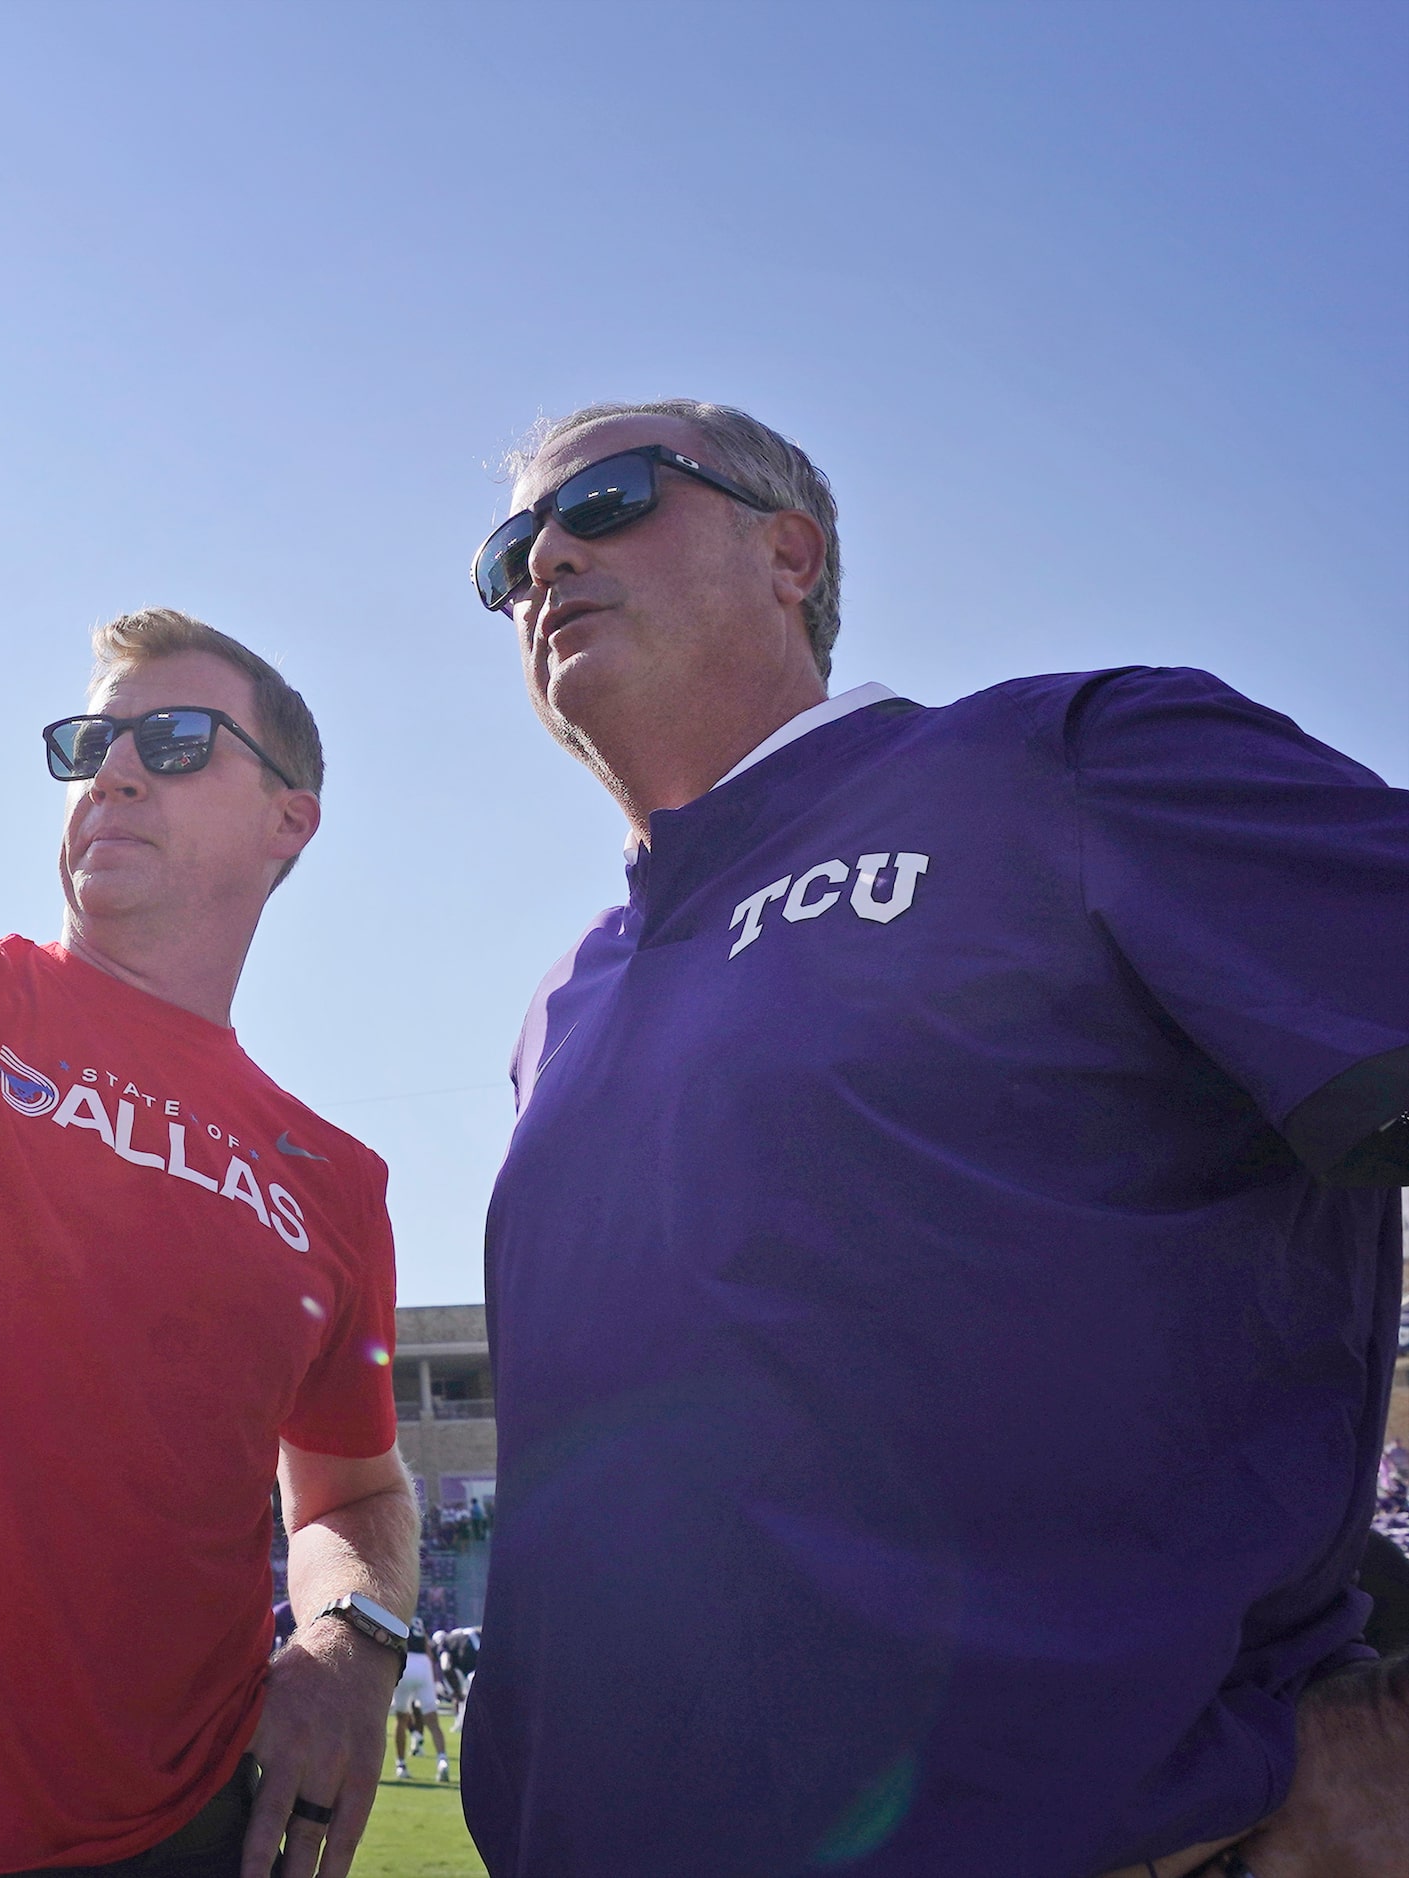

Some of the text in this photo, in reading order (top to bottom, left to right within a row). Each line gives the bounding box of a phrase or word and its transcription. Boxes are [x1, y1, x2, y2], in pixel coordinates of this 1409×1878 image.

[728, 852, 930, 961] TCU
[81, 1067, 240, 1149] STATE OF
